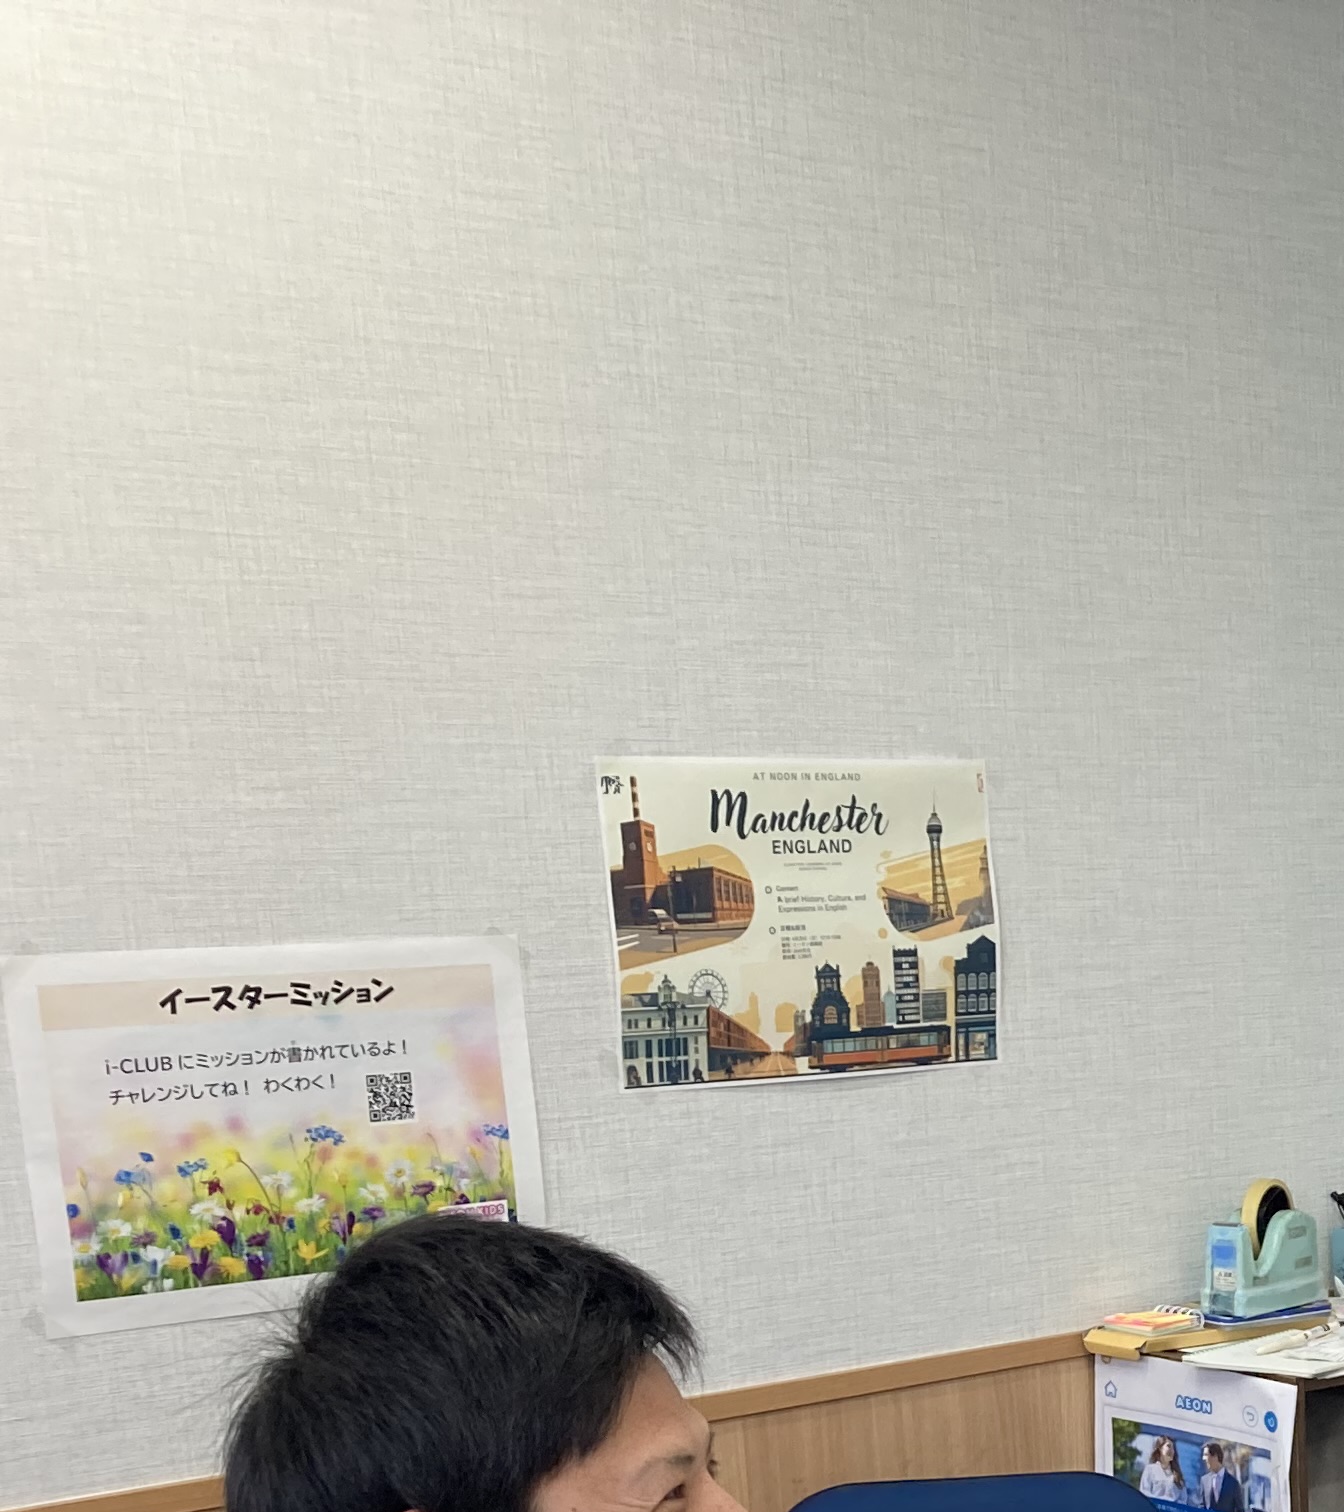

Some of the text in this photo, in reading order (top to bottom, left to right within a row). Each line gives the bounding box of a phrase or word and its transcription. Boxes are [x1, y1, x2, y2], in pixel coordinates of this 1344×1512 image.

[753, 772, 861, 782] AT NOON IN ENGLAND
[709, 789, 889, 840] Manchester
[772, 838, 852, 855] ENGLAND
[158, 977, 396, 1016] イースターミッション
[104, 1055, 174, 1076] i-CLUB
[1175, 1395, 1213, 1415] AEON
